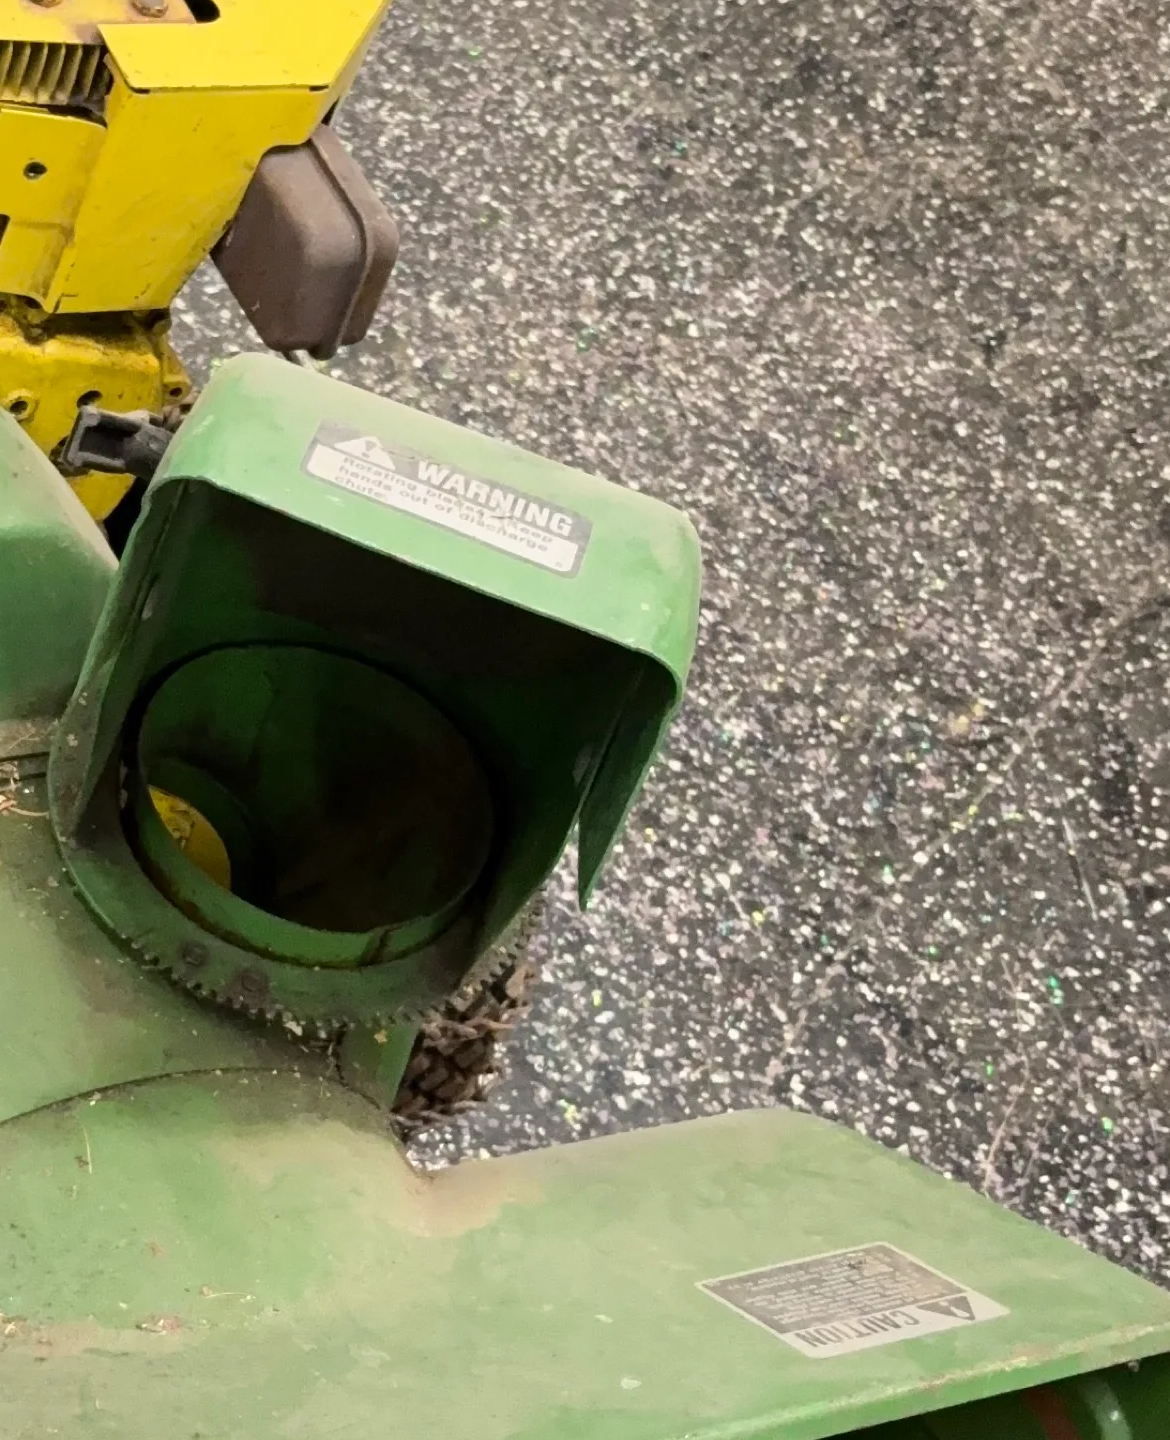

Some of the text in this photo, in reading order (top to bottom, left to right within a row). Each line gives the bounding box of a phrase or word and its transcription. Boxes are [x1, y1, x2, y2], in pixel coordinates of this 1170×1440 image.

[343, 457, 418, 492] Rotating
[417, 460, 574, 538] WARNING
[338, 465, 549, 552] hands out of discharge
[794, 1309, 921, 1348] CAUTION
